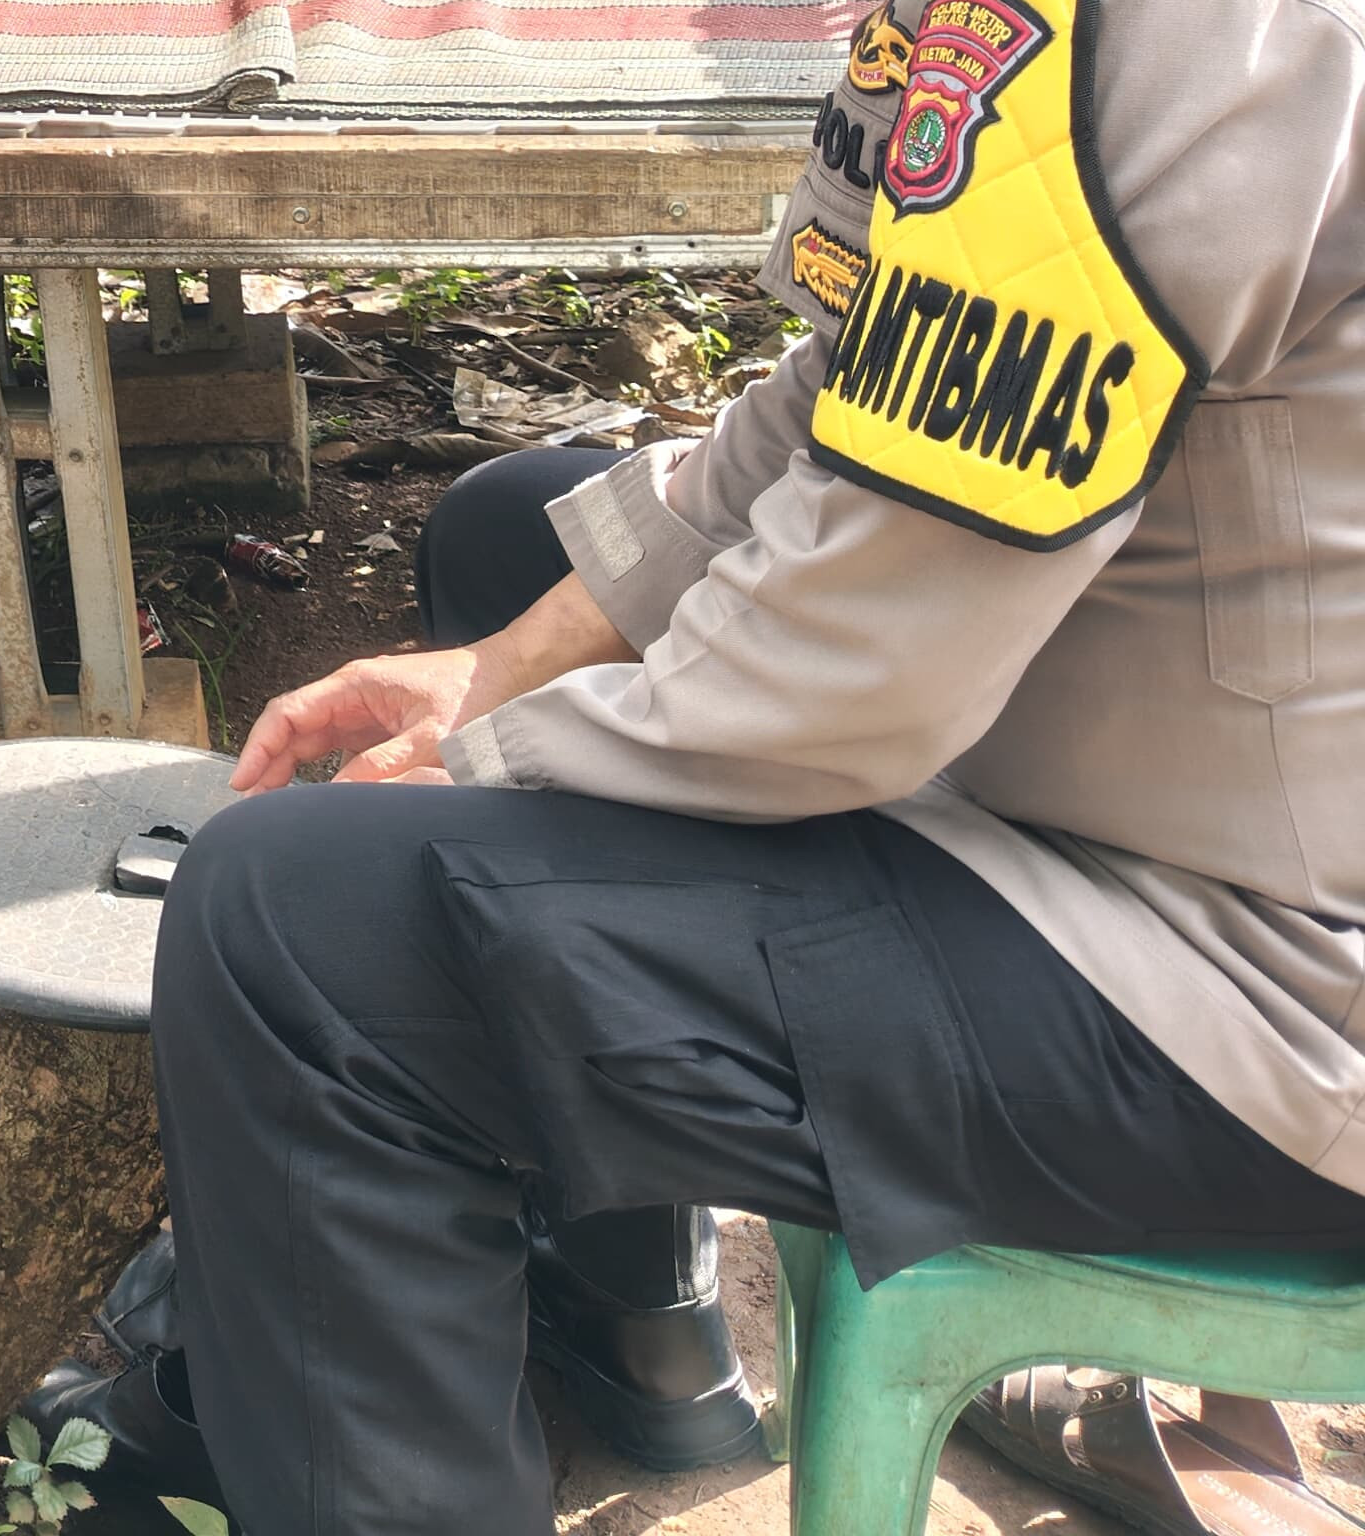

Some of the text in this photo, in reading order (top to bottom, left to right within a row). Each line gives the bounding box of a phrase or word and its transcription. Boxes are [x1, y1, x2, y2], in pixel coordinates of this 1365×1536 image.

[928, 13, 1002, 49] BEKASI KOTA
[931, 1, 1013, 42] POLRES METRO
[918, 47, 986, 81] METRO JAYA
[825, 259, 1135, 490] AMTIBMAS
